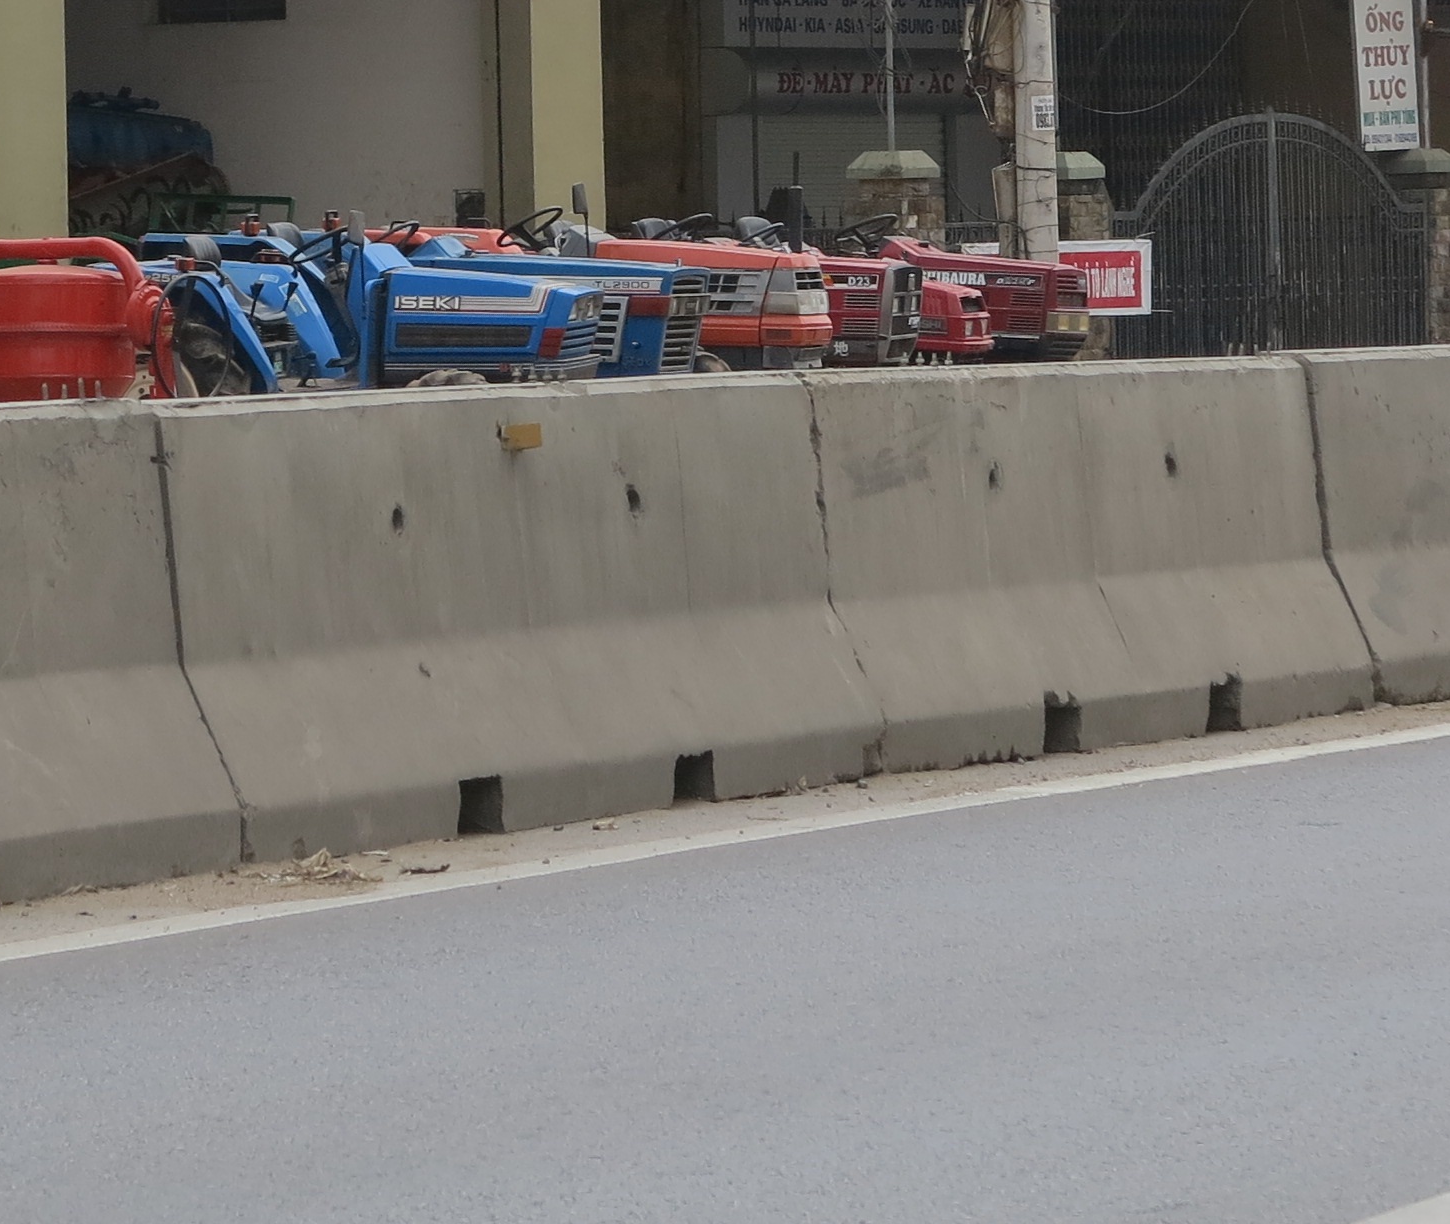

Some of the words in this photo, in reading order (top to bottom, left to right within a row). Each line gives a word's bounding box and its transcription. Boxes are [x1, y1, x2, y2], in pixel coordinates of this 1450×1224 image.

[738, 16, 797, 34] HYNDAI
[873, 17, 935, 36] SSUNG
[1365, 3, 1405, 33] ỐNG
[1361, 38, 1411, 68] THỦY
[1368, 75, 1407, 106] LỰC
[847, 276, 870, 287] D23
[394, 295, 461, 311] ISEKI
